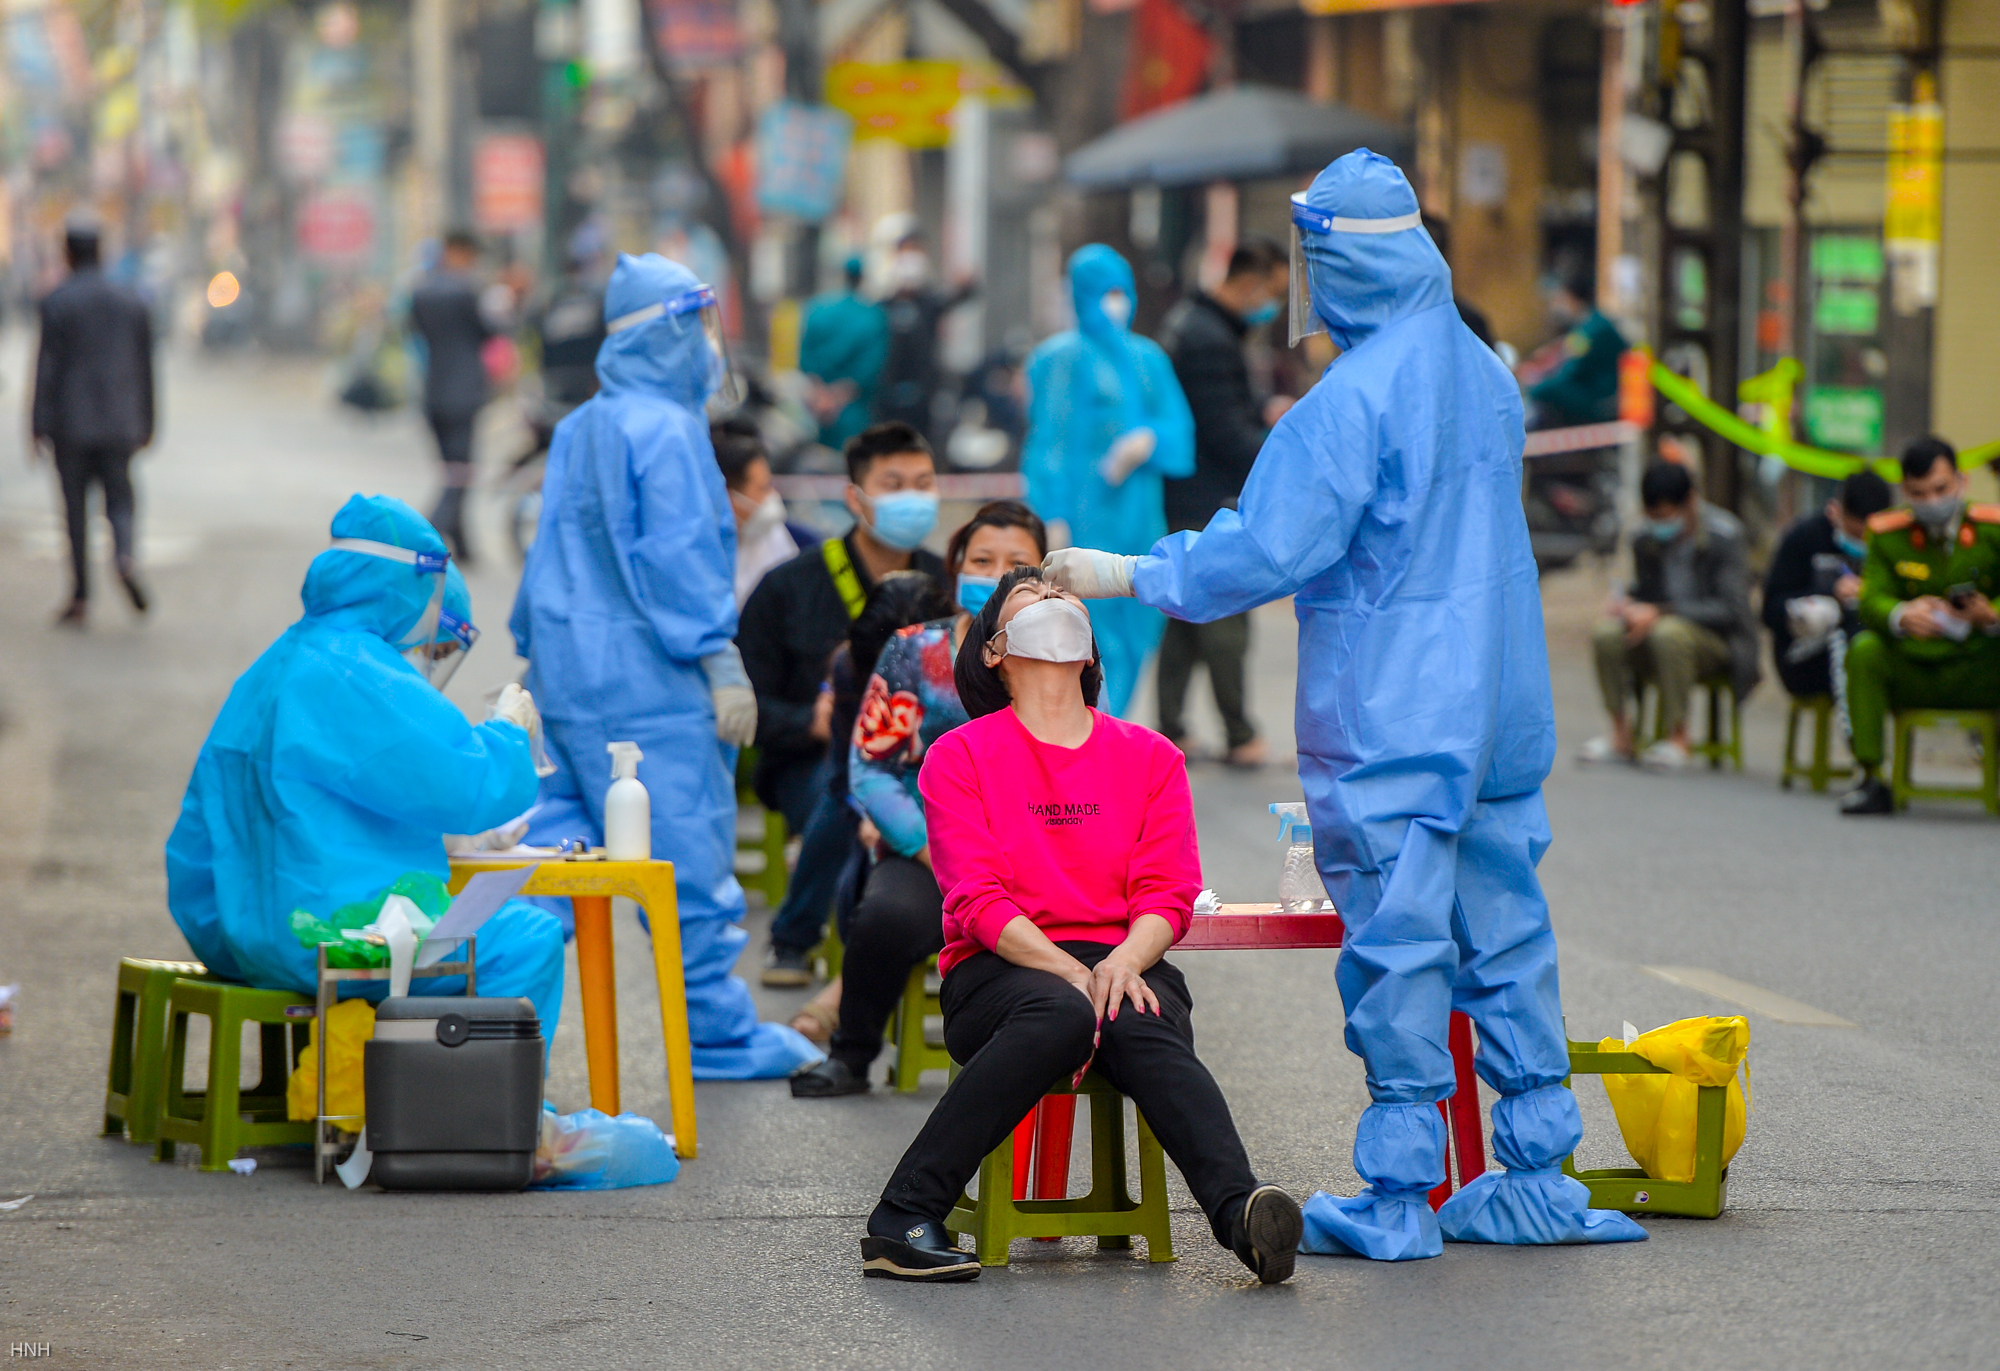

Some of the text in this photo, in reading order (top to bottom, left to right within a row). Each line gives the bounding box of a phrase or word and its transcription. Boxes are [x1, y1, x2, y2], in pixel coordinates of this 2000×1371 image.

[1028, 802, 1100, 816] HAND MADE
[1045, 816, 1083, 826] visionday
